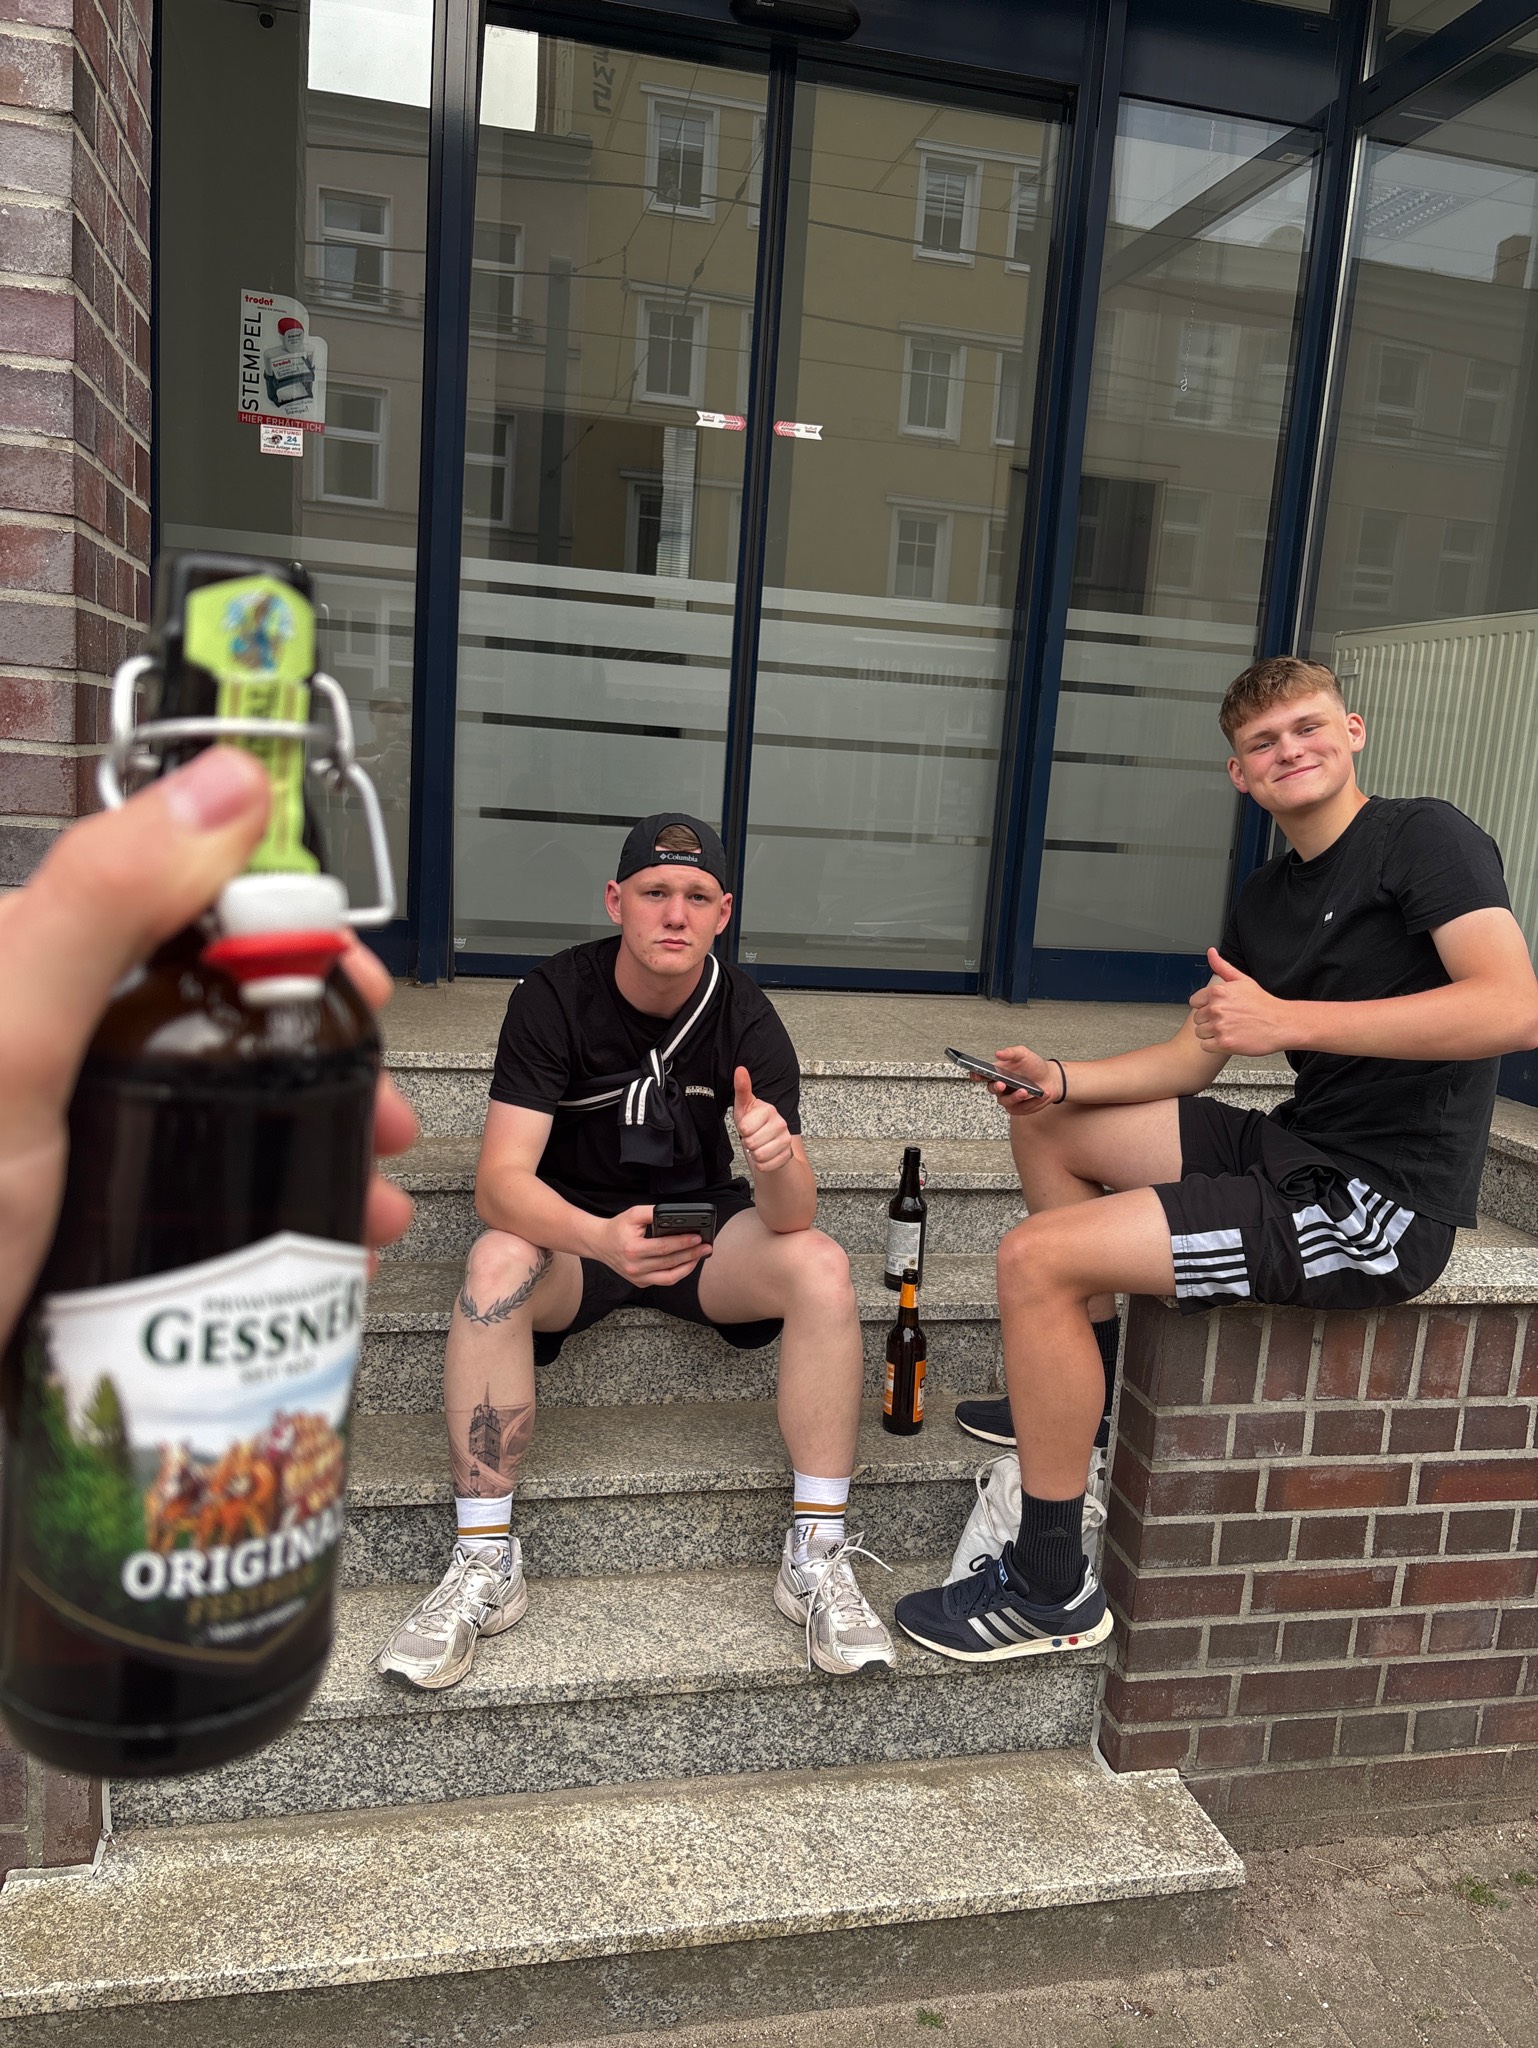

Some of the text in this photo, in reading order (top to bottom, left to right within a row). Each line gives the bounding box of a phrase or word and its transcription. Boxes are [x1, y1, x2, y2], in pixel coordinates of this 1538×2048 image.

[245, 294, 274, 306] trodat
[242, 312, 261, 412] STEMPEL
[272, 359, 291, 367] trodat
[241, 413, 322, 432] HIER ERHÄLTLICH
[666, 853, 698, 863] Columbia
[120, 1499, 344, 1601] ORIGINA
